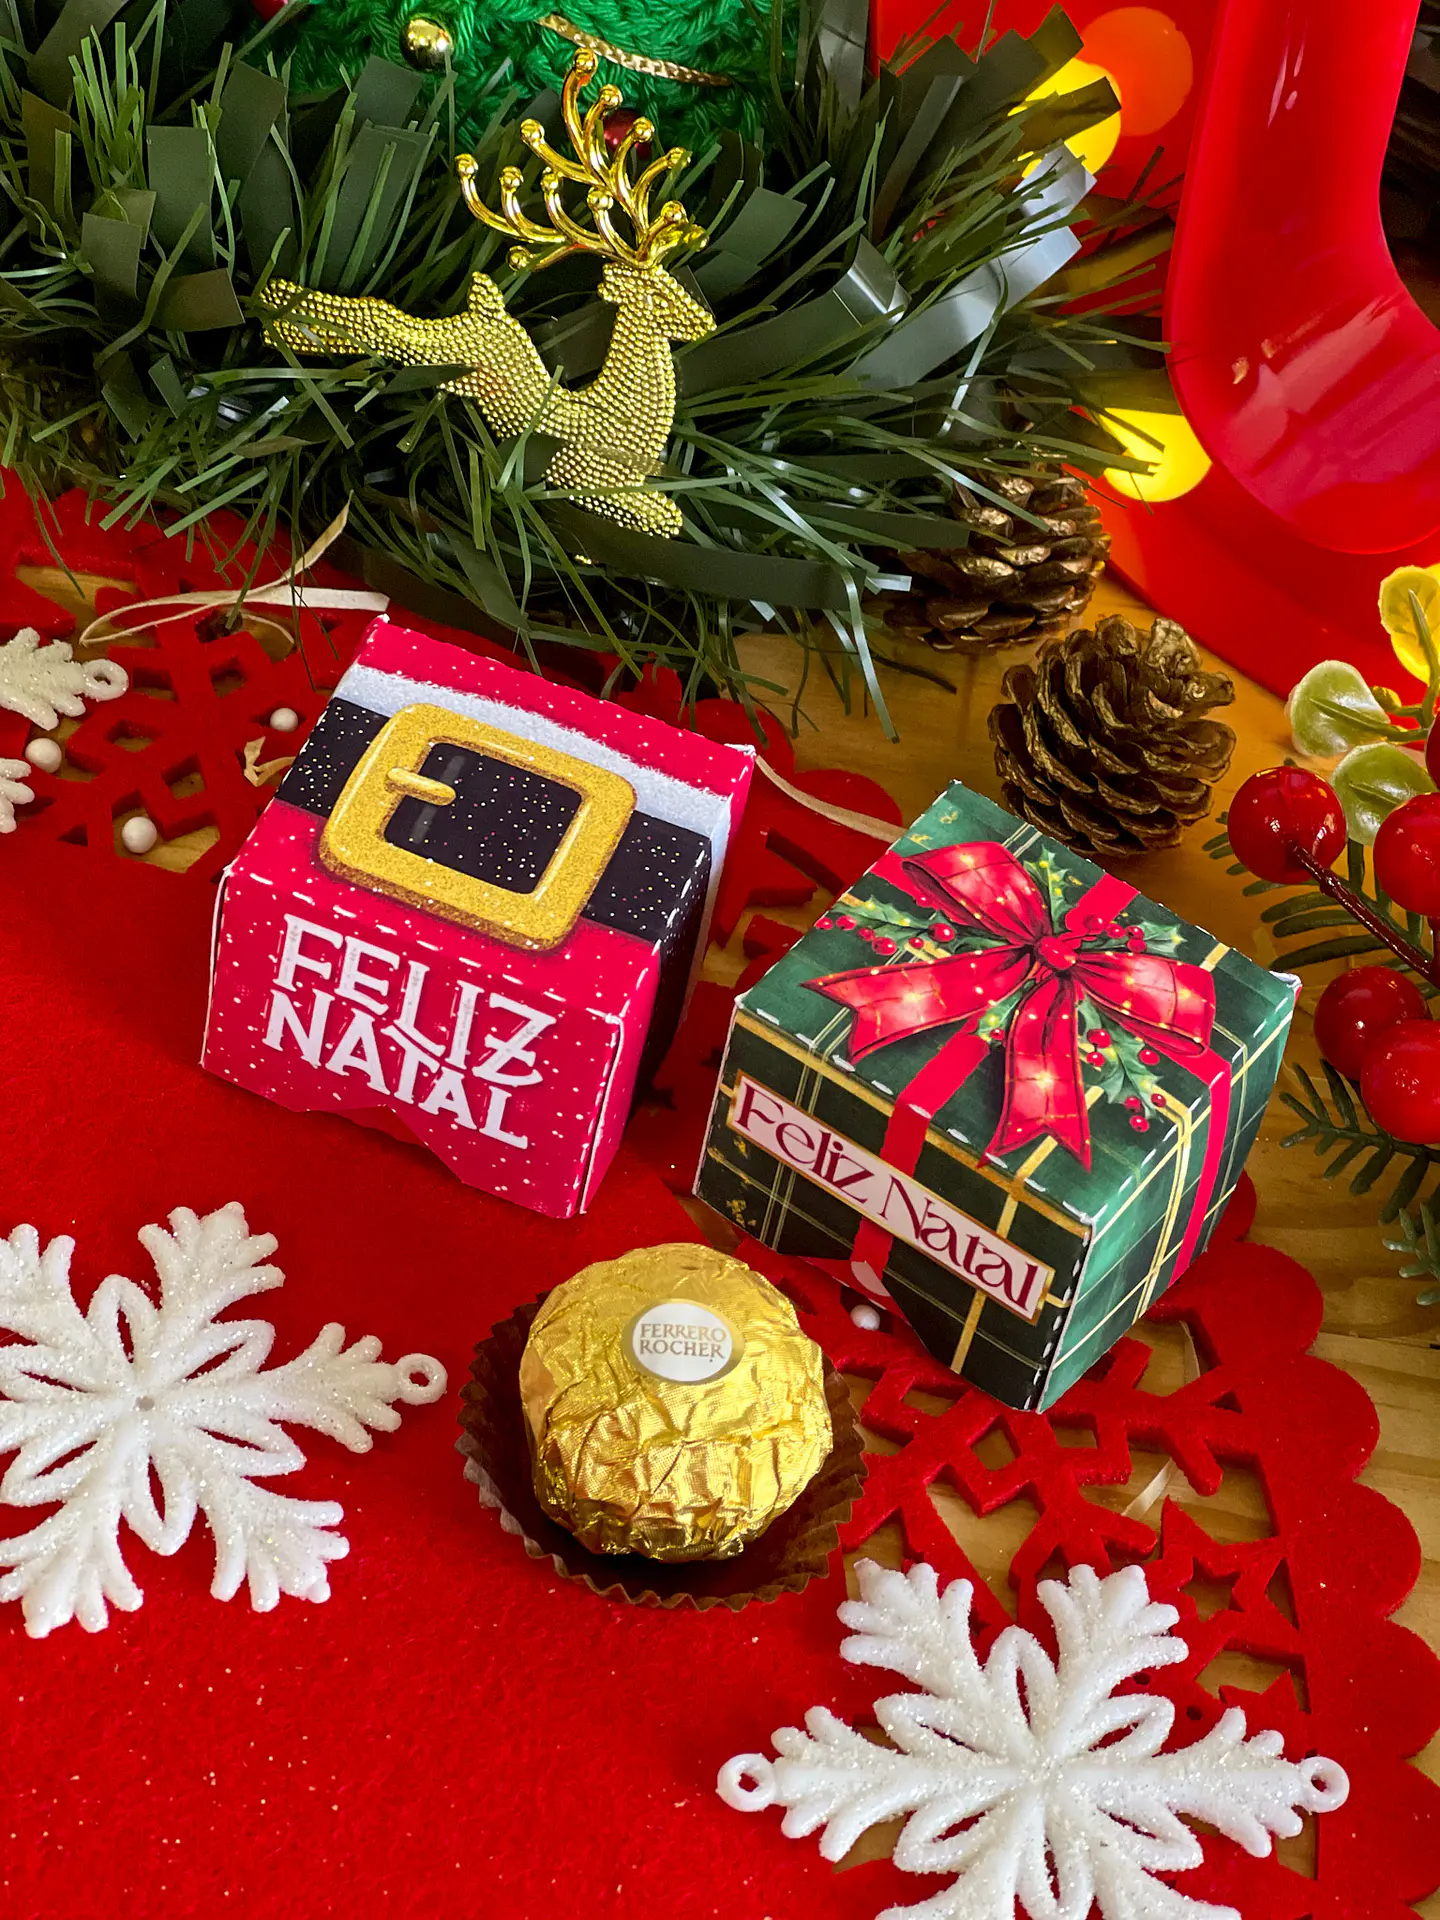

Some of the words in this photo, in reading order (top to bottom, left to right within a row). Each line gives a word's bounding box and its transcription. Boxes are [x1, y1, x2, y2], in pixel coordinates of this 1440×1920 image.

[262, 988, 528, 1150] NATAL
[273, 913, 557, 1087] FELIZ
[734, 1081, 875, 1204] Feliz
[877, 1174, 1039, 1311] Natal
[640, 1323, 727, 1342] FERRERO
[640, 1340, 725, 1359] ROCHER
